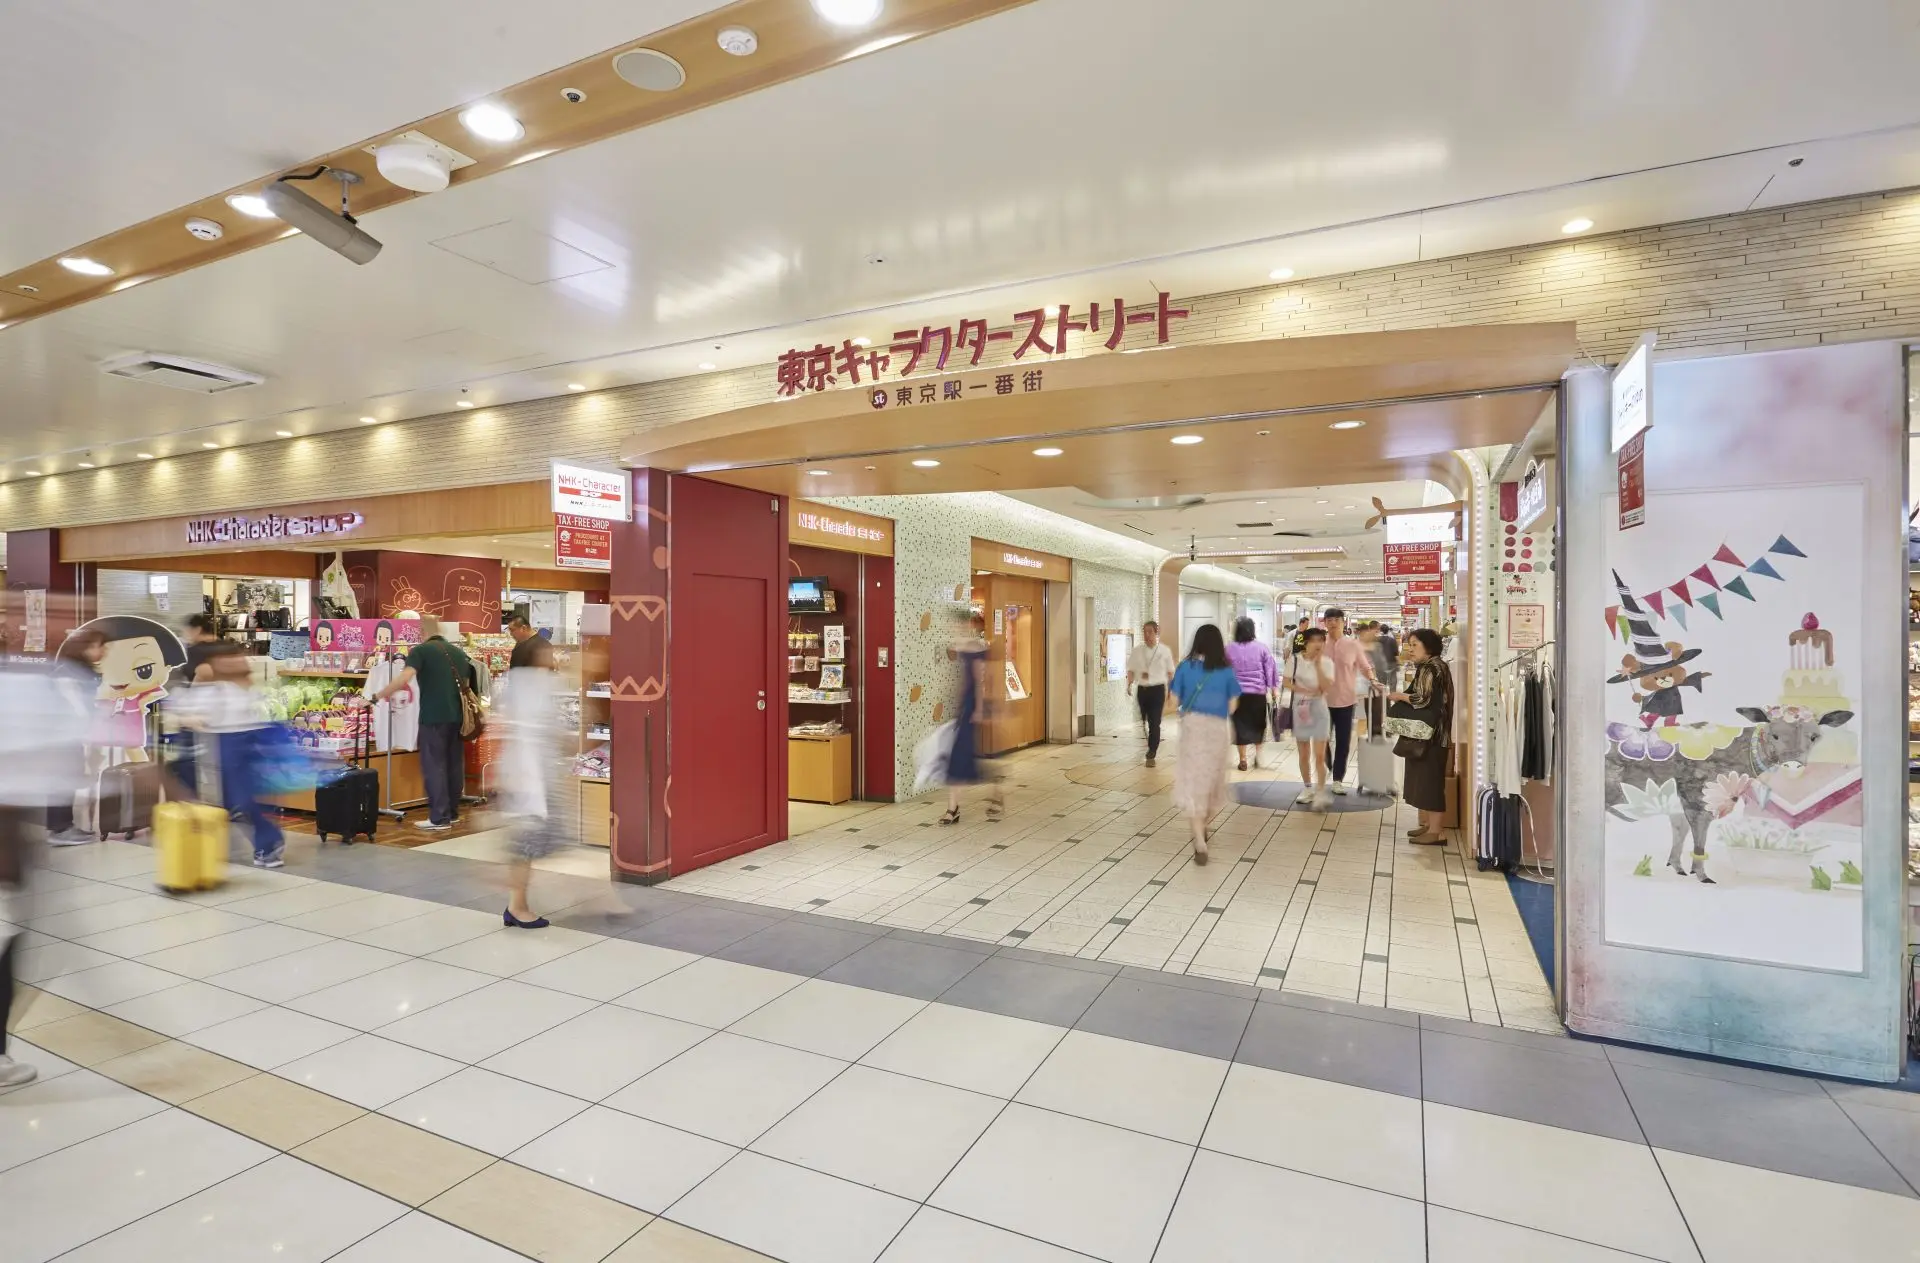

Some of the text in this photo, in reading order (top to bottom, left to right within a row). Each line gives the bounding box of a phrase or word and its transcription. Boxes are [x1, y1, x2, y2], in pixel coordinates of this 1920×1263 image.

[777, 291, 1190, 396] 東京キャラクターストリート
[896, 370, 1044, 407] 東京駅一番街
[557, 514, 610, 530] TAX-FREE SHOP
[1385, 543, 1439, 553] TAX-FREE SHOP
